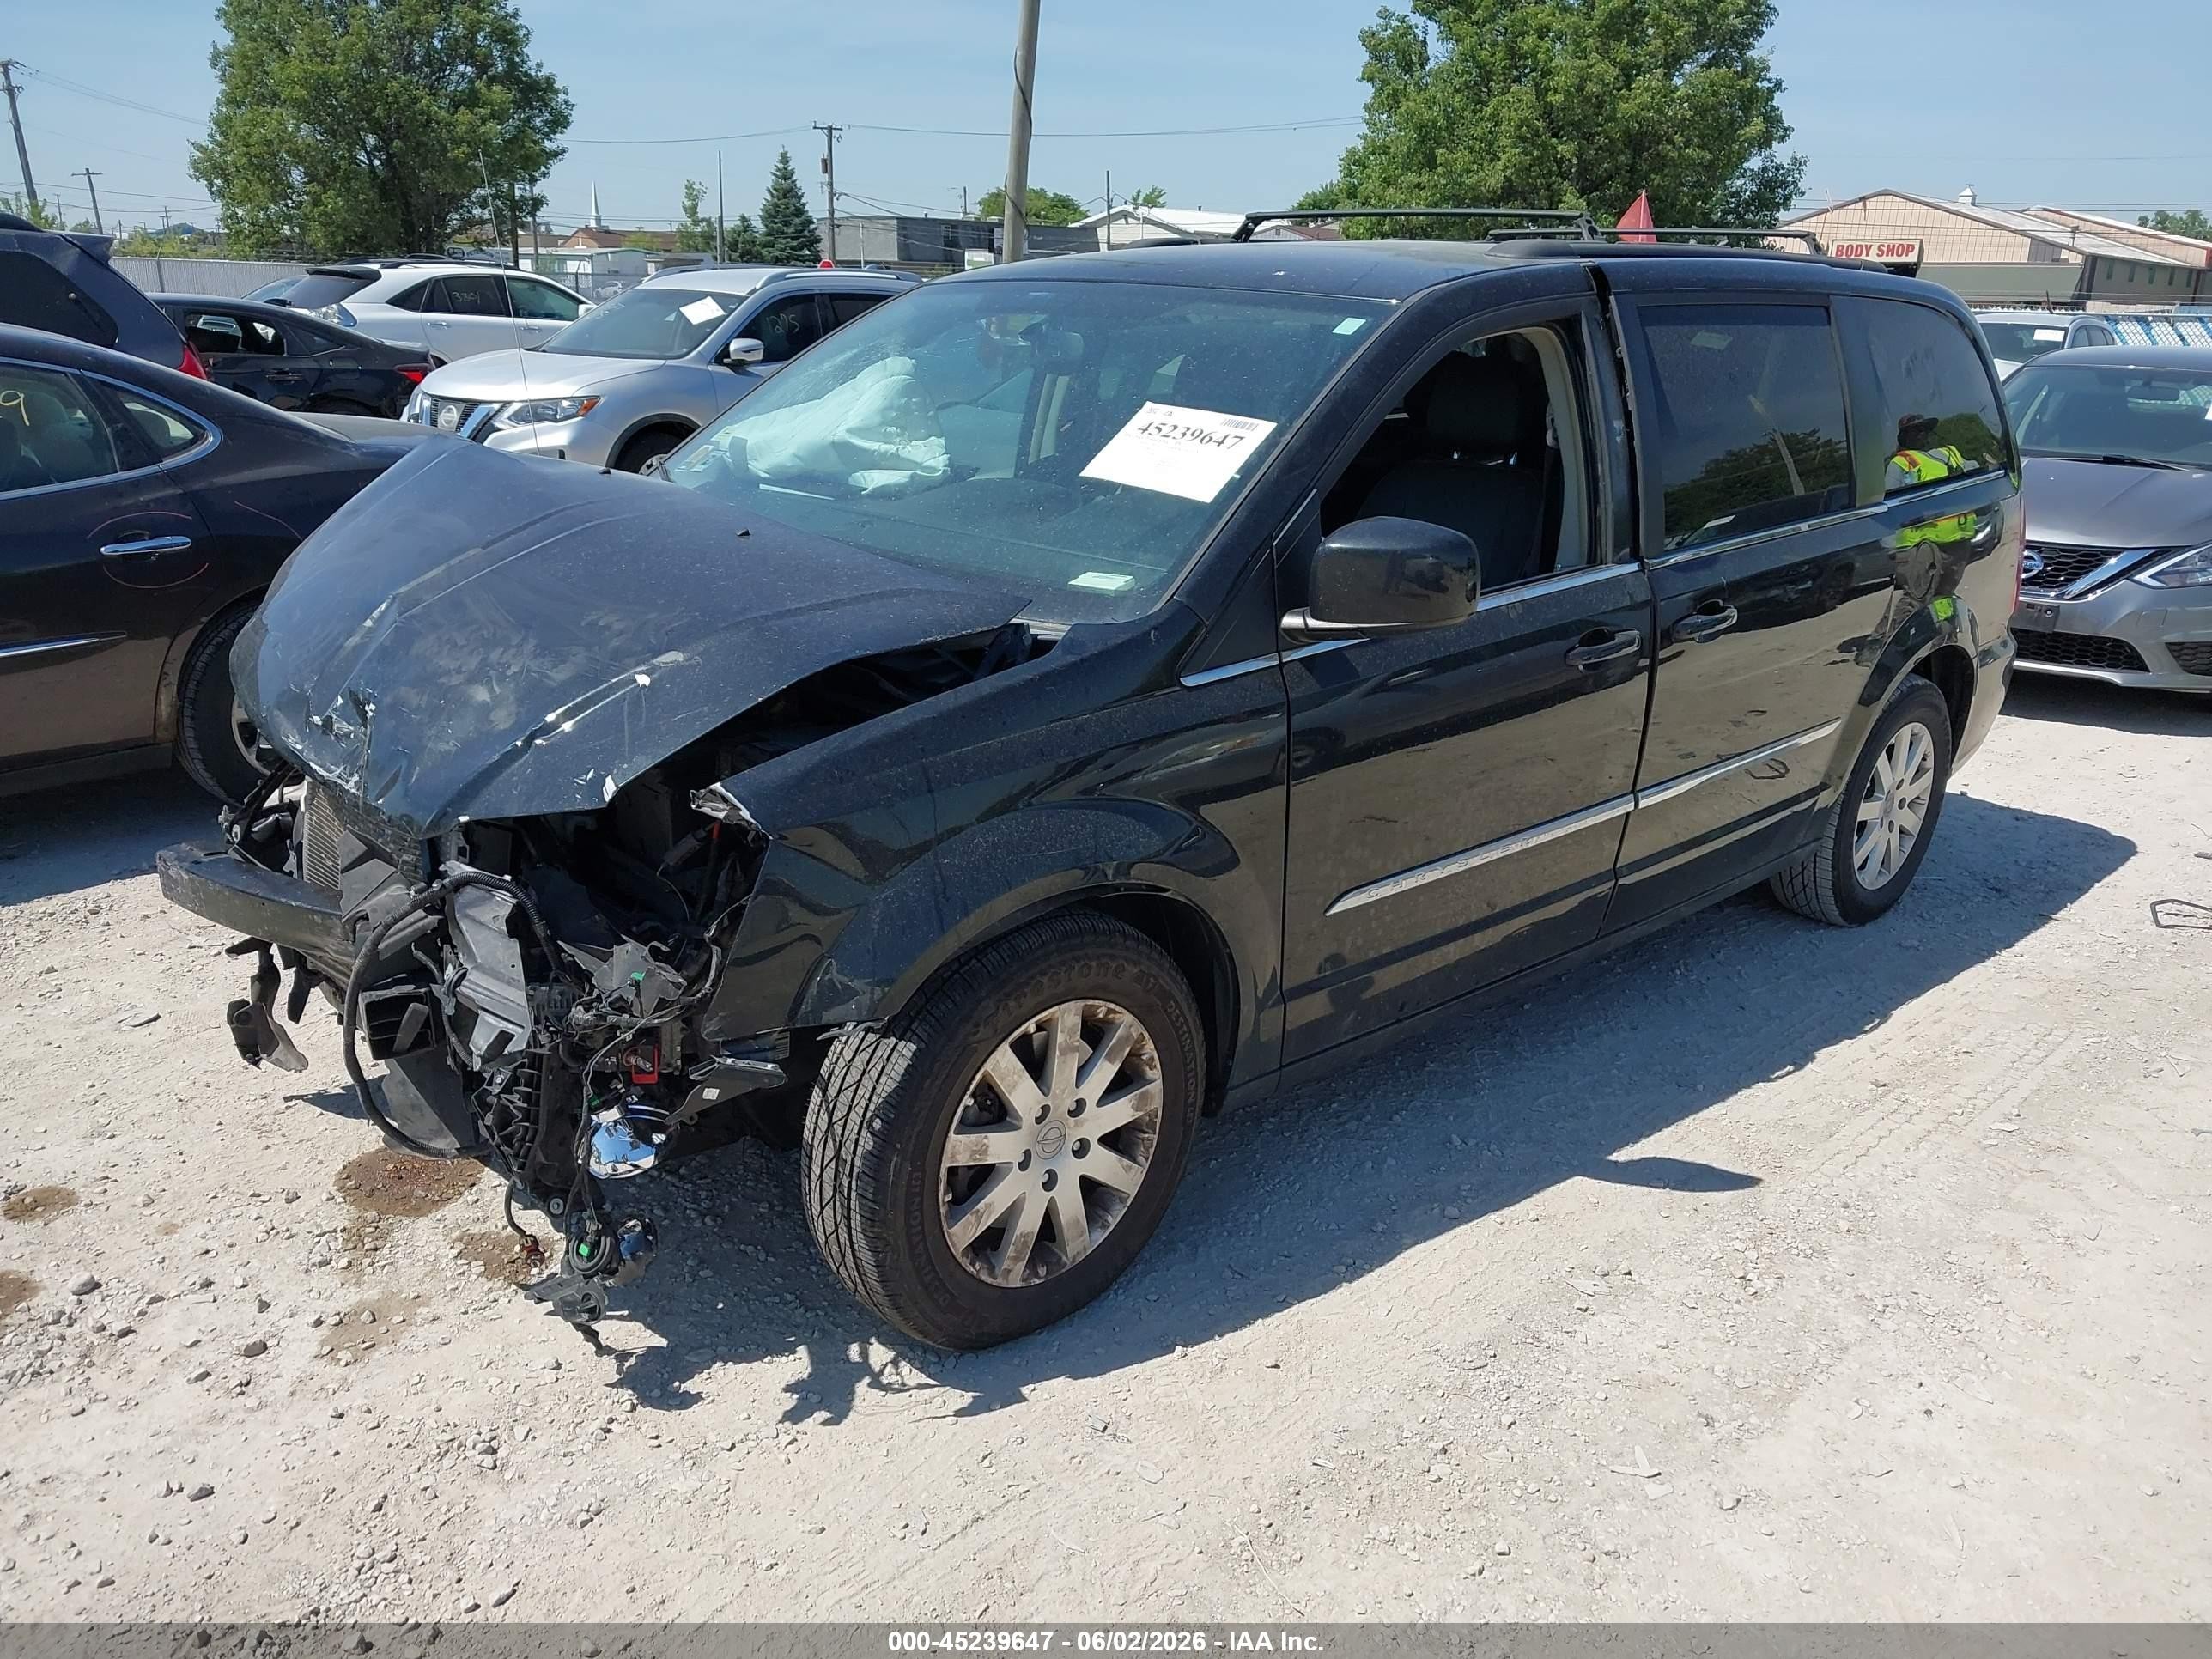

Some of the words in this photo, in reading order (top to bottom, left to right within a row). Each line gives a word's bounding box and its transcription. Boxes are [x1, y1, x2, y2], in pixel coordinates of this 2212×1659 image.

[1836, 244, 1872, 258] BODY
[1875, 243, 1916, 258] SHOP
[0, 389, 31, 427] 9
[1136, 420, 1246, 450] 45239647
